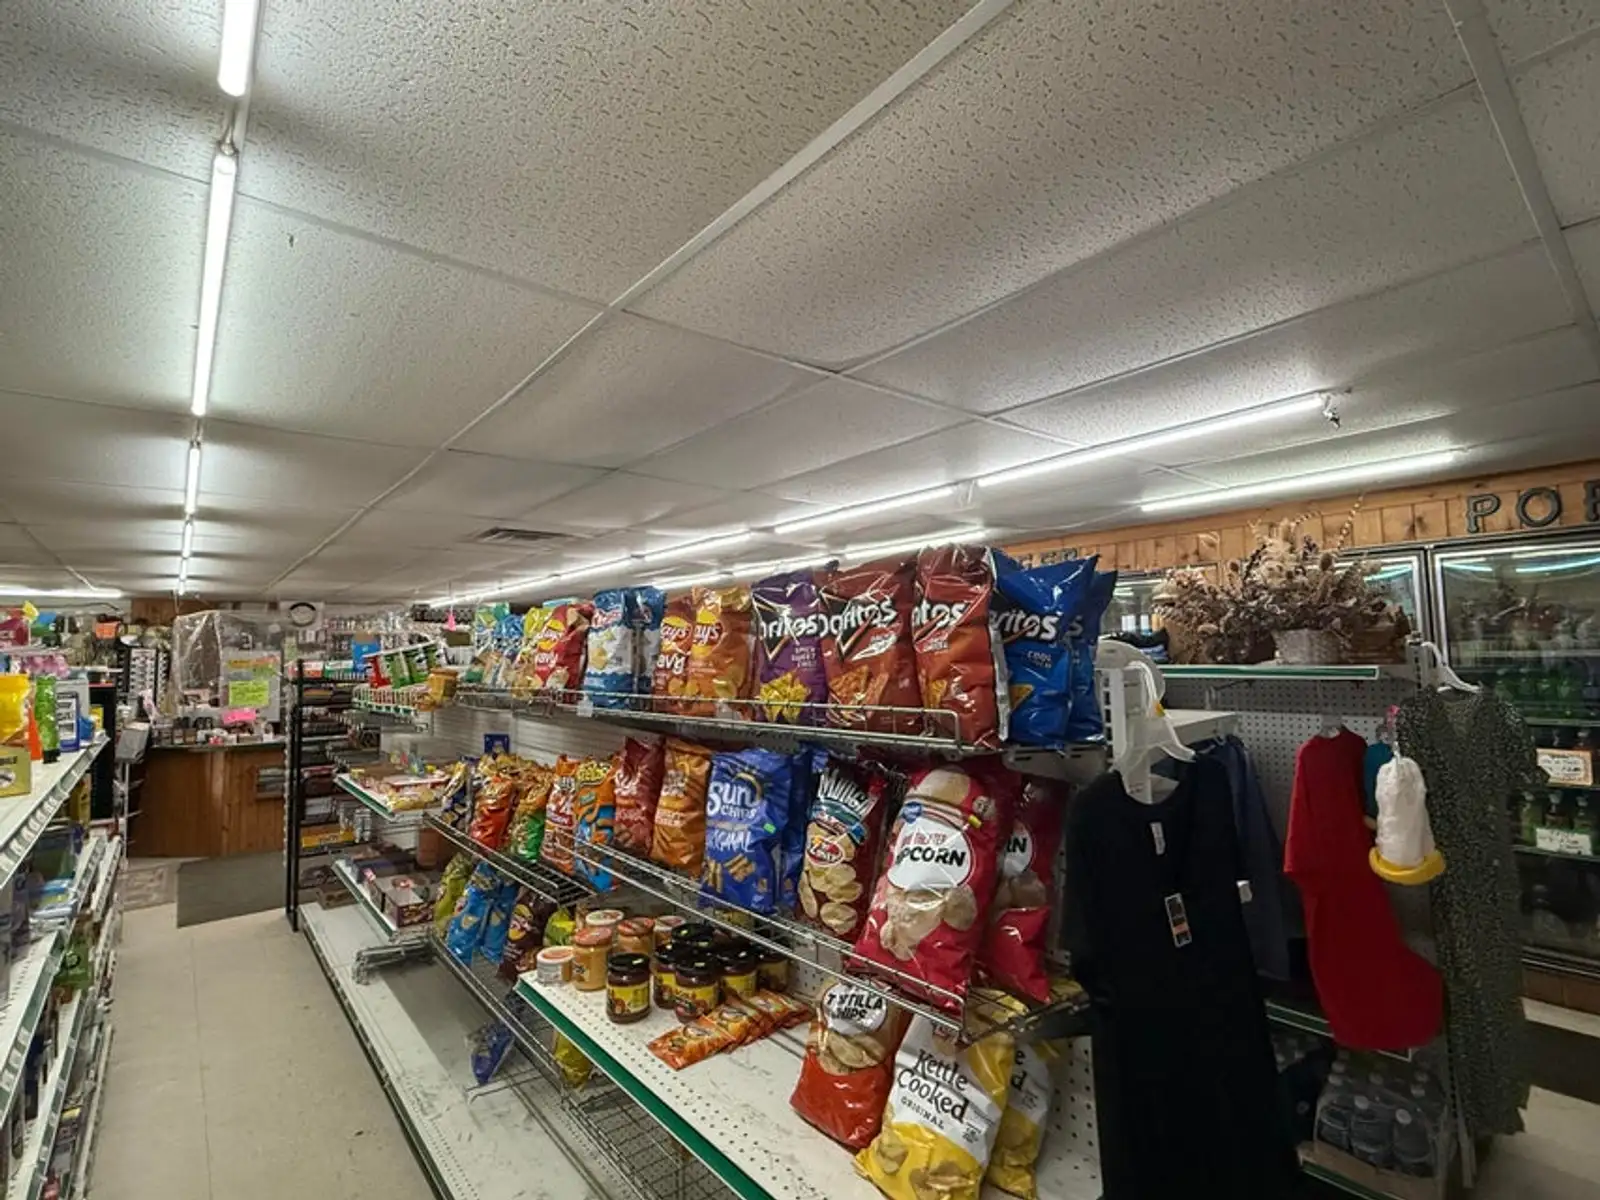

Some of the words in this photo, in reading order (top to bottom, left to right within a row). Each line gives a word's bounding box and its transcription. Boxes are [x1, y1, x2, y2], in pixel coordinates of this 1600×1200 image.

[656, 654, 686, 676] avy
[706, 781, 753, 817] Sun
[913, 1048, 969, 1092] Kettle
[896, 1067, 971, 1124] Cooked
[900, 1096, 946, 1131] ORIGINAL
